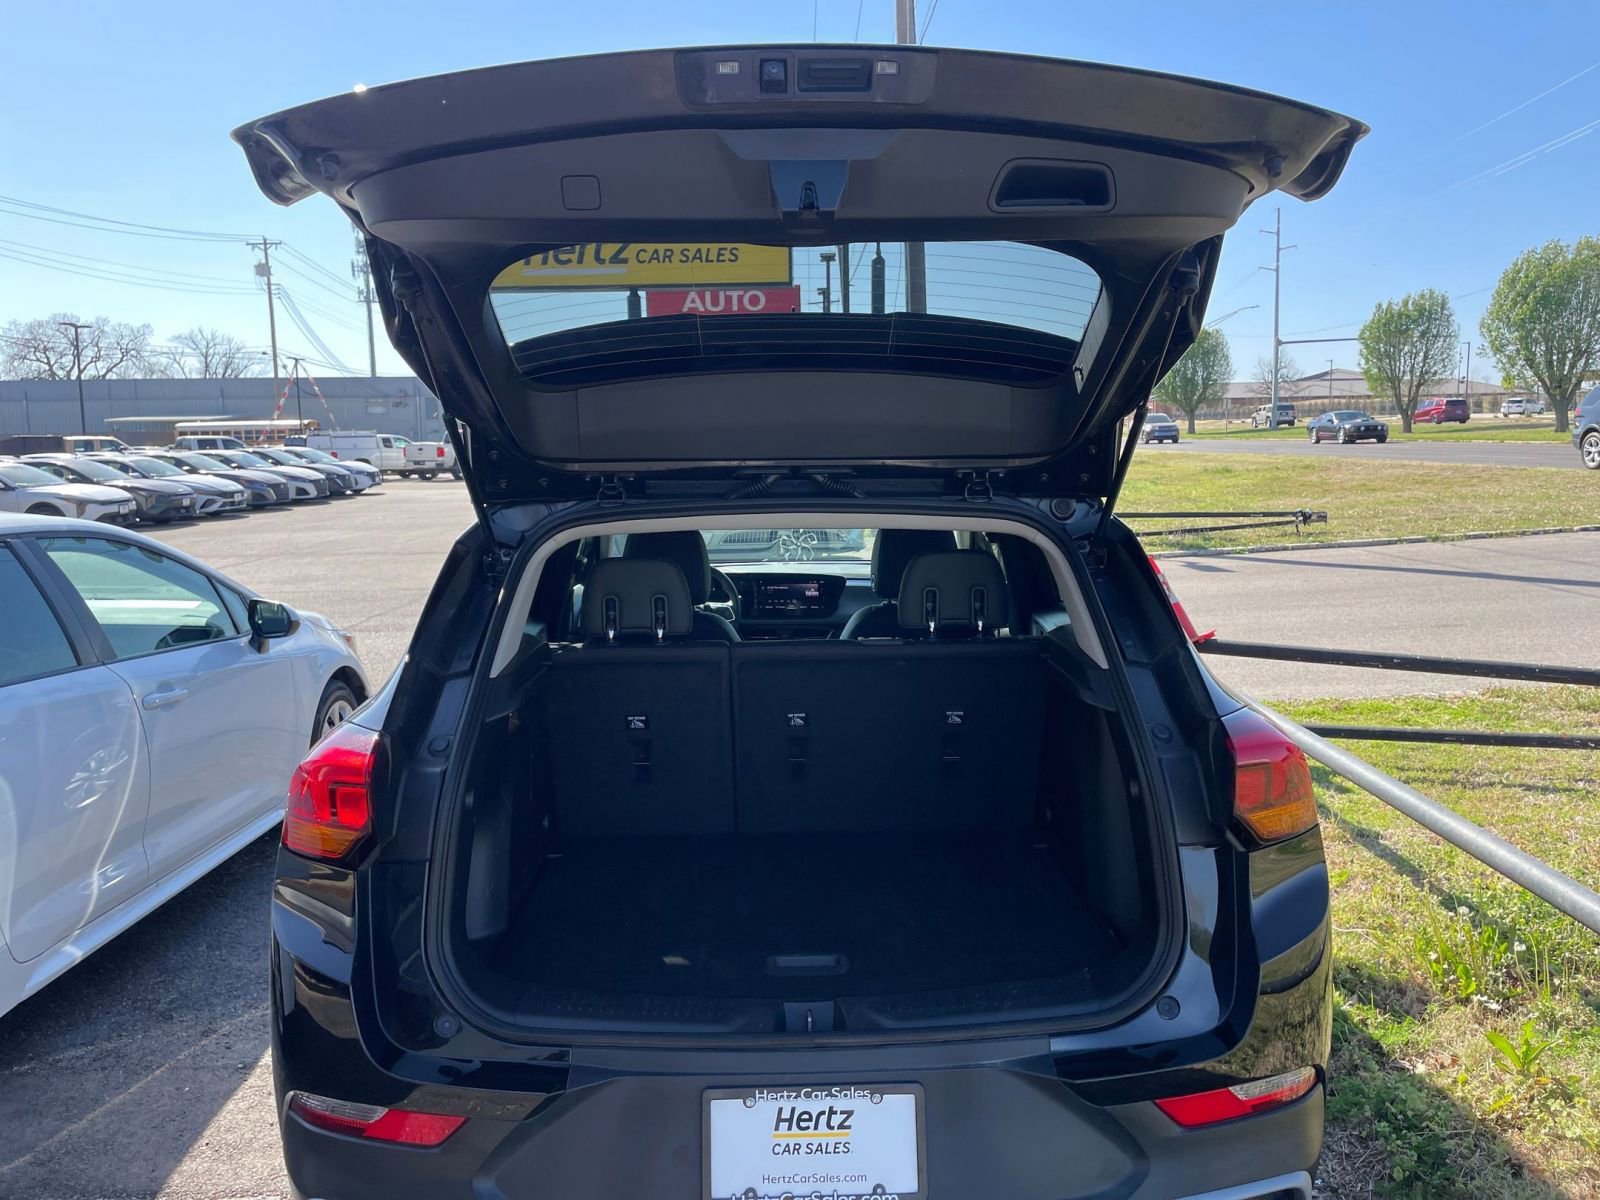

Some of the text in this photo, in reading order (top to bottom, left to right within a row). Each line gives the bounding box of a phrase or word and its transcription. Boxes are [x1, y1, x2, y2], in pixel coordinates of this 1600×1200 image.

[635, 248, 674, 264] CAR
[679, 247, 739, 263] SALES
[682, 289, 766, 312] AUTO
[755, 1086, 871, 1102] Hertz Car Sales
[774, 1105, 855, 1131] Hertz
[772, 1141, 851, 1156] CAR SALES
[762, 1173, 867, 1185] HertzCarSales.com
